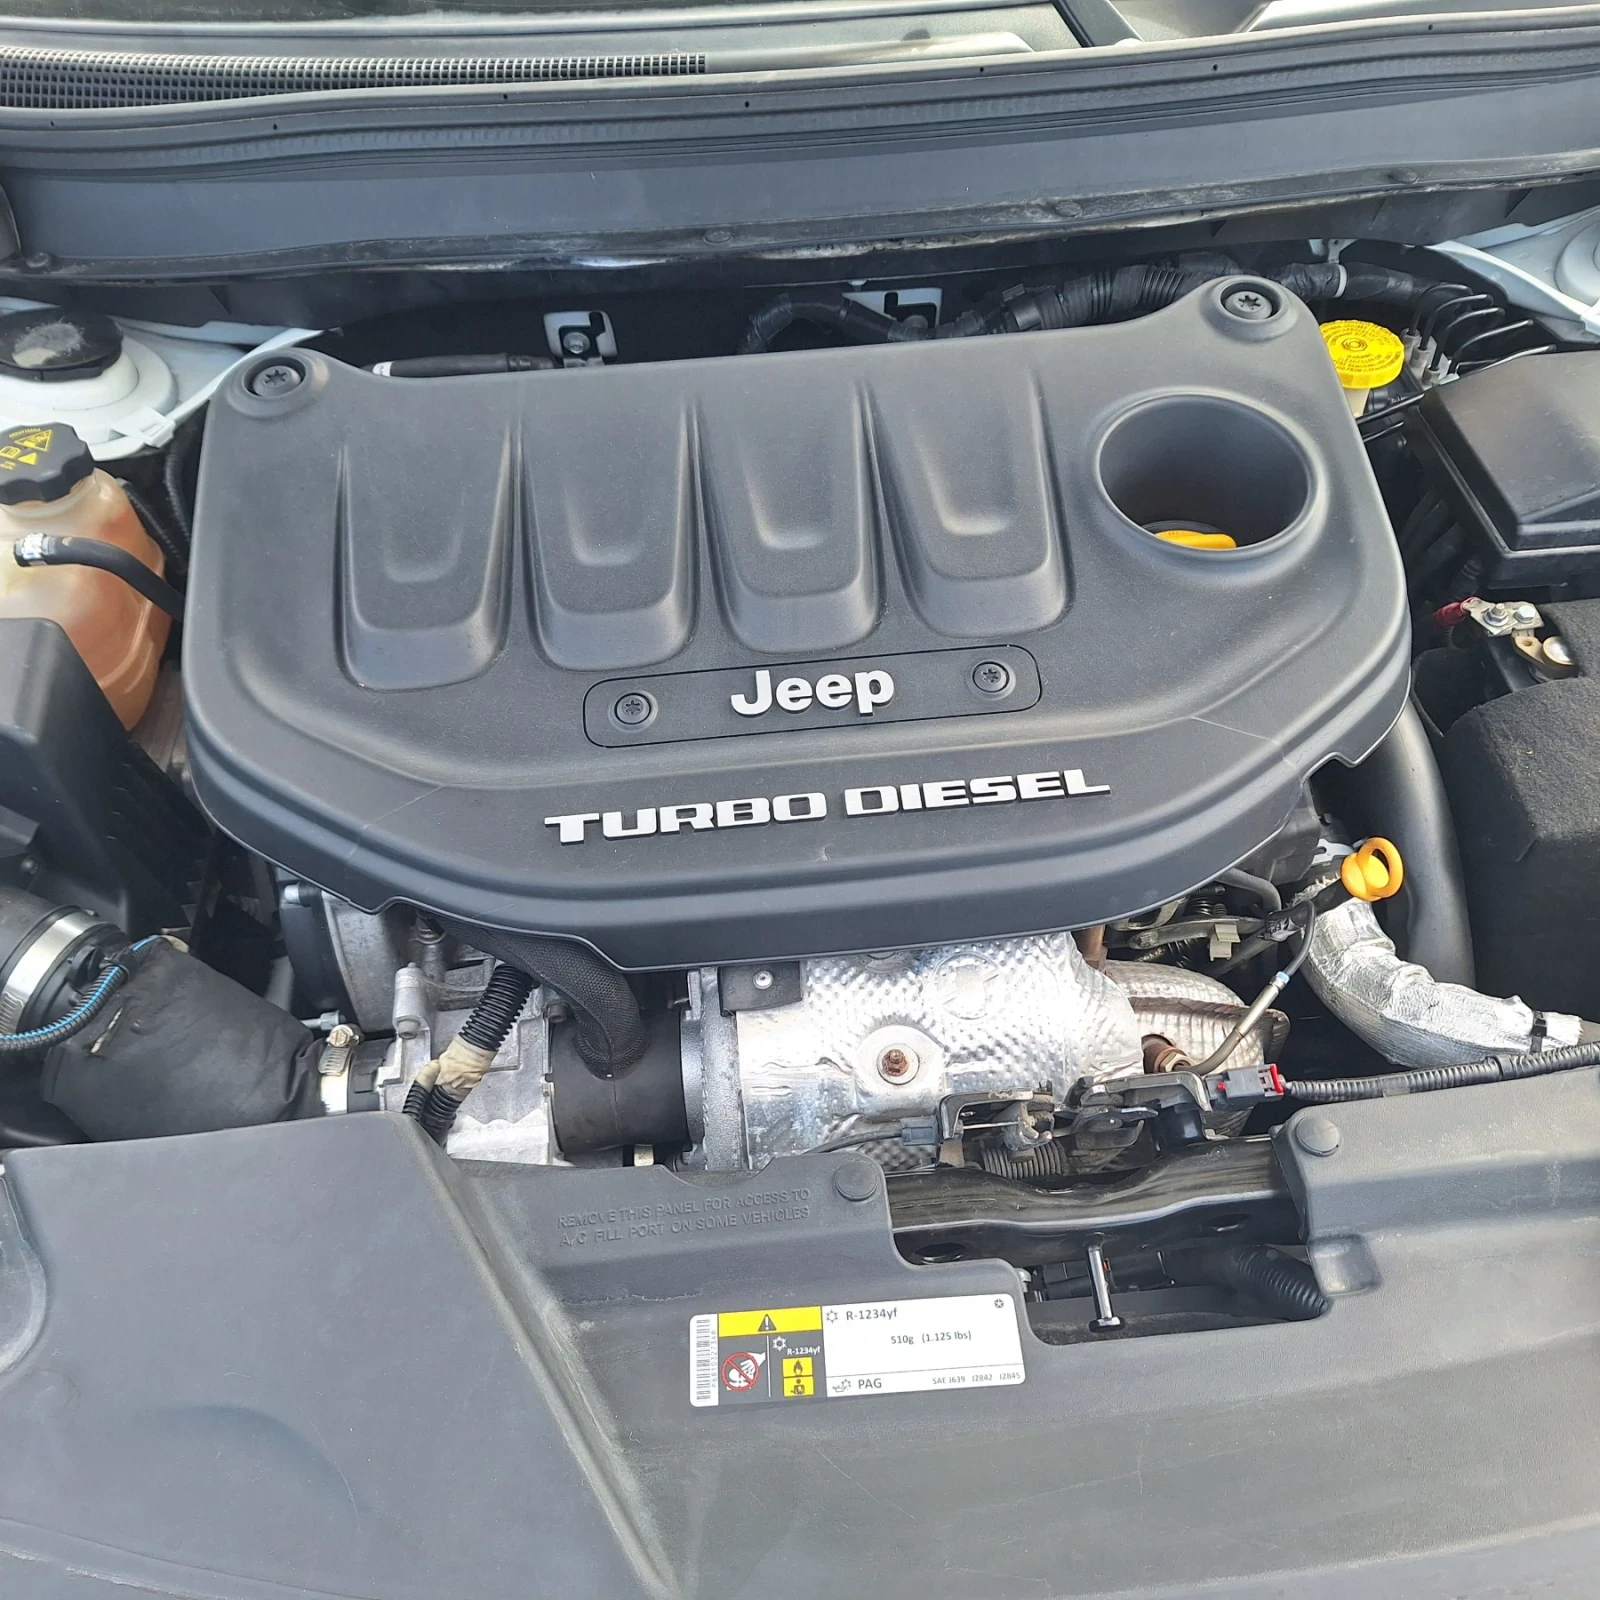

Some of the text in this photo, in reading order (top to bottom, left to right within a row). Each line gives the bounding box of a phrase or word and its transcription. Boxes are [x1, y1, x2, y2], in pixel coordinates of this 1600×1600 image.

[731, 669, 896, 717] Jeep
[544, 768, 1111, 845] TURBO DIESEL
[557, 1188, 811, 1229] REMOVE THIS PANEL FOR ACCESS TO
[560, 1205, 811, 1248] A/C FILL PORT ON SOME VEHICLES
[846, 1307, 898, 1321] R-1234yf
[891, 1330, 972, 1345] 510g (1.125 lbs)
[786, 1345, 821, 1356] R-1234yf
[858, 1378, 882, 1389] PAG
[932, 1376, 947, 1385] SAE
[949, 1375, 967, 1384] J639
